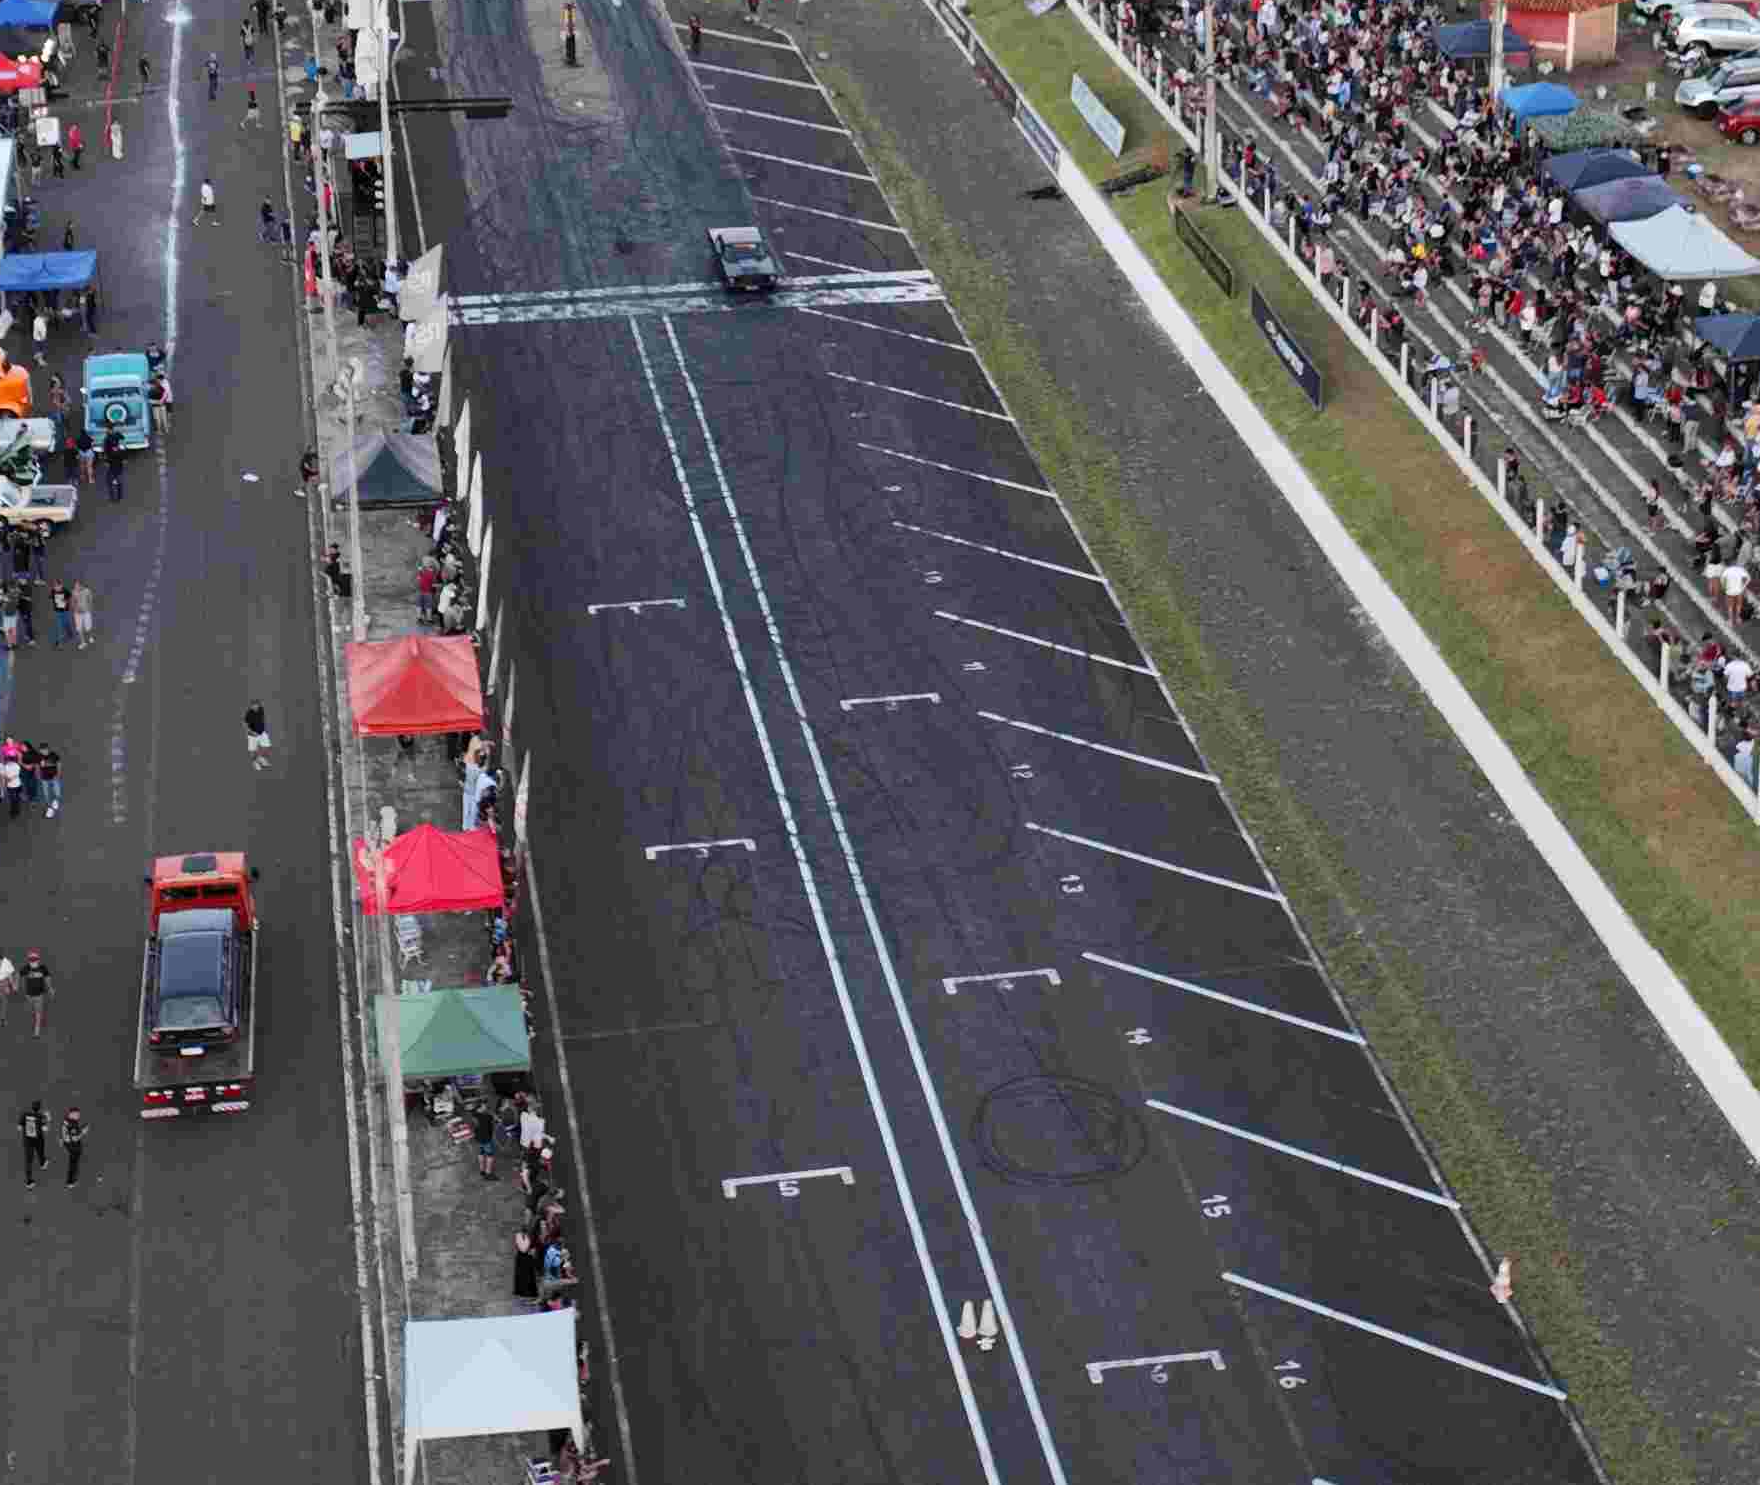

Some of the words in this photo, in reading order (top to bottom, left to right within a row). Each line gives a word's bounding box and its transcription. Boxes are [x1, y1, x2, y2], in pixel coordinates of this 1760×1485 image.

[1009, 763, 1034, 779] 12
[1059, 874, 1085, 894] 13
[1124, 1027, 1152, 1045] 14
[777, 1180, 801, 1197] 5
[1200, 1194, 1232, 1219] 15
[1274, 1360, 1307, 1389] 16
